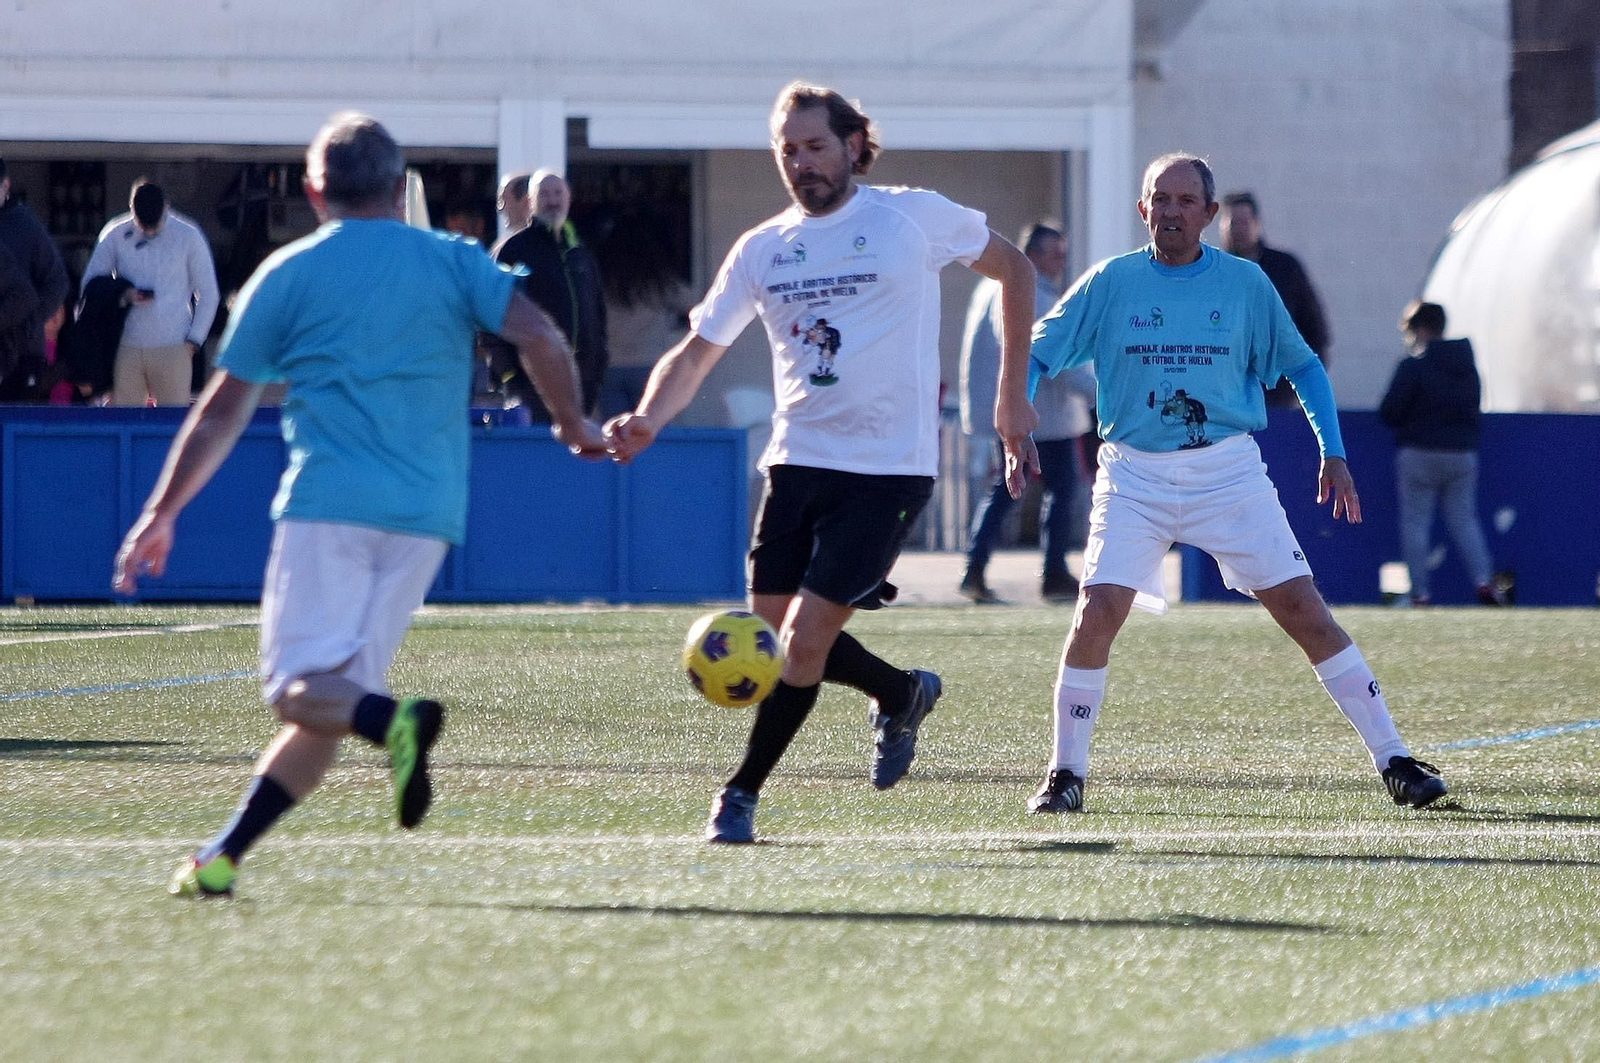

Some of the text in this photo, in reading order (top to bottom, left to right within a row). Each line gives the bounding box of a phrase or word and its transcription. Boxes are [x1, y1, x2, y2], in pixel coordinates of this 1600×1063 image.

[783, 294, 792, 304] DE
[820, 289, 830, 299] DE
[831, 286, 858, 297] HUELVA
[1125, 344, 1159, 355] HOMENAJE
[1142, 354, 1213, 366] DE FÚTBOL DE HUELVA
